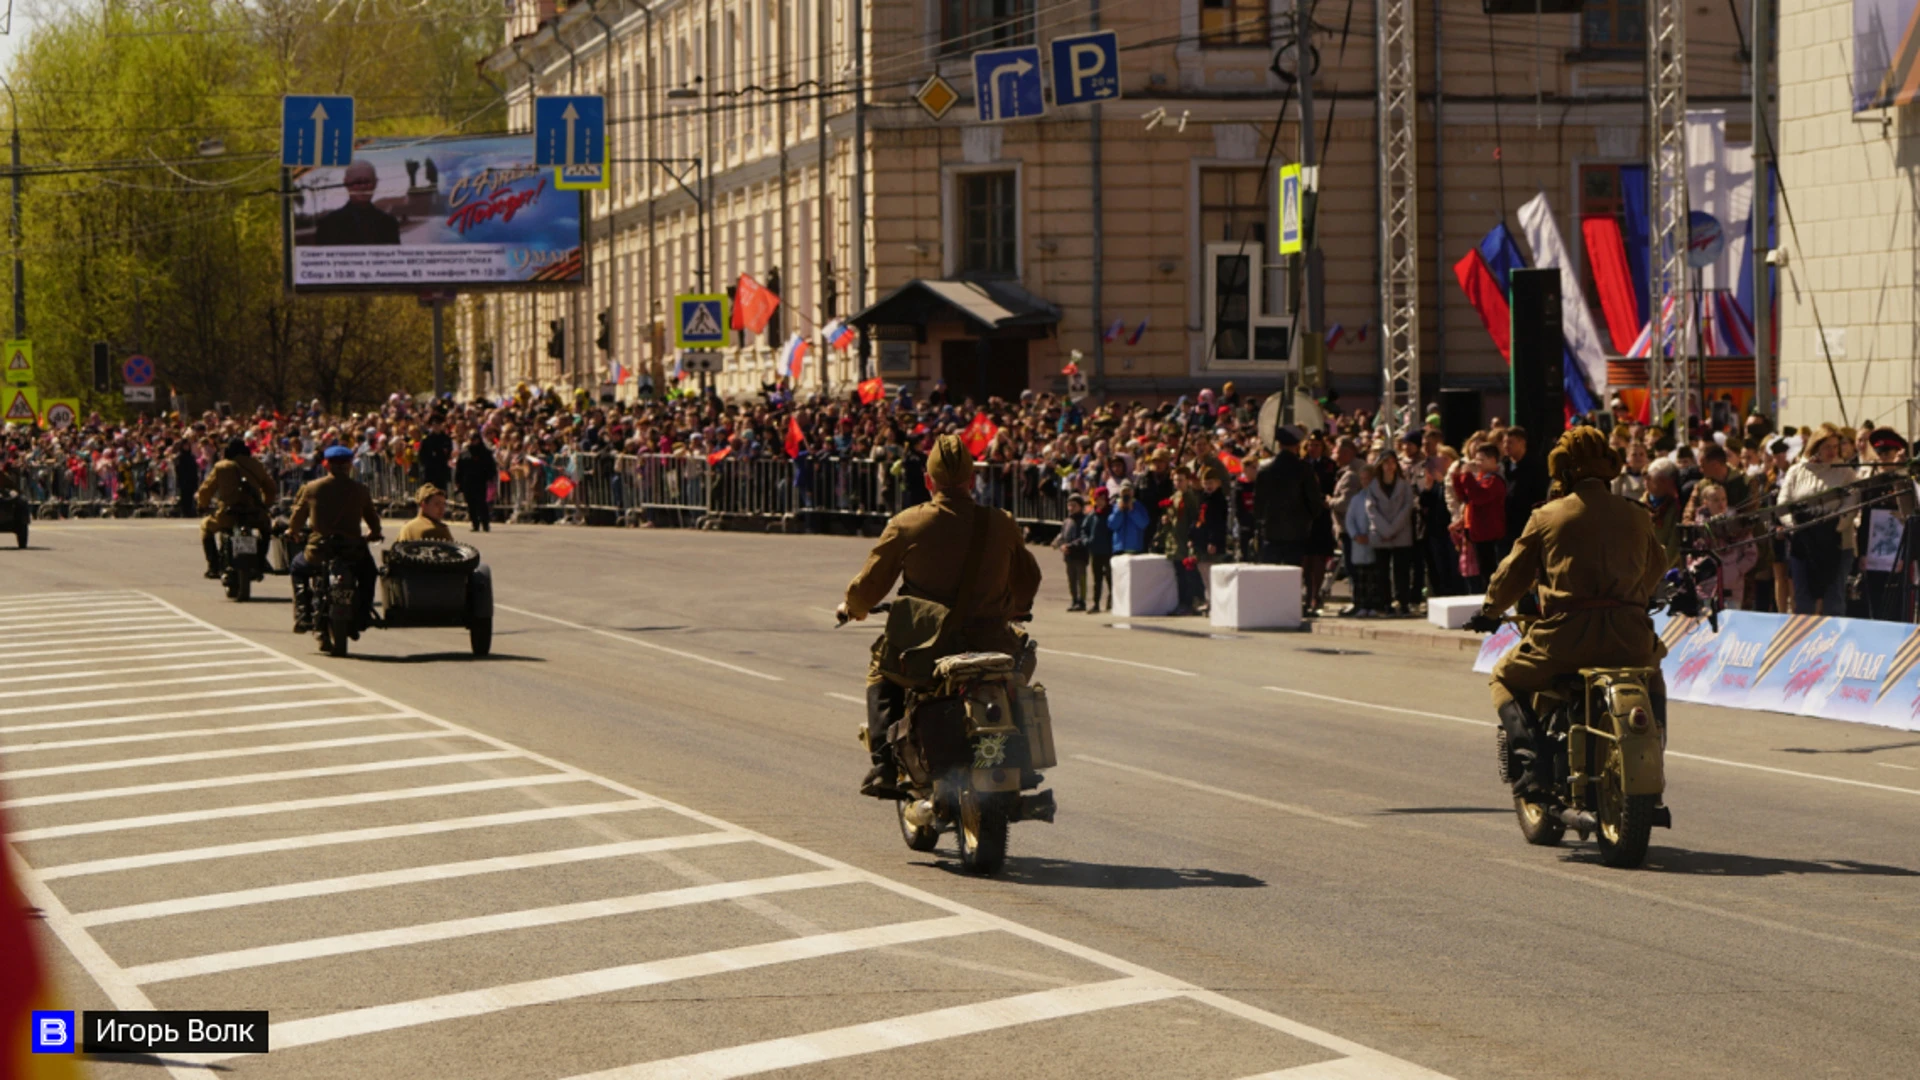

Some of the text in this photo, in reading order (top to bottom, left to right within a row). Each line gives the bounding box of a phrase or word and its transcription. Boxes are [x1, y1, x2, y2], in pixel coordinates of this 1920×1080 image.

[1069, 43, 1106, 98] P
[1091, 77, 1105, 88] 20
[54, 411, 70, 423] 40
